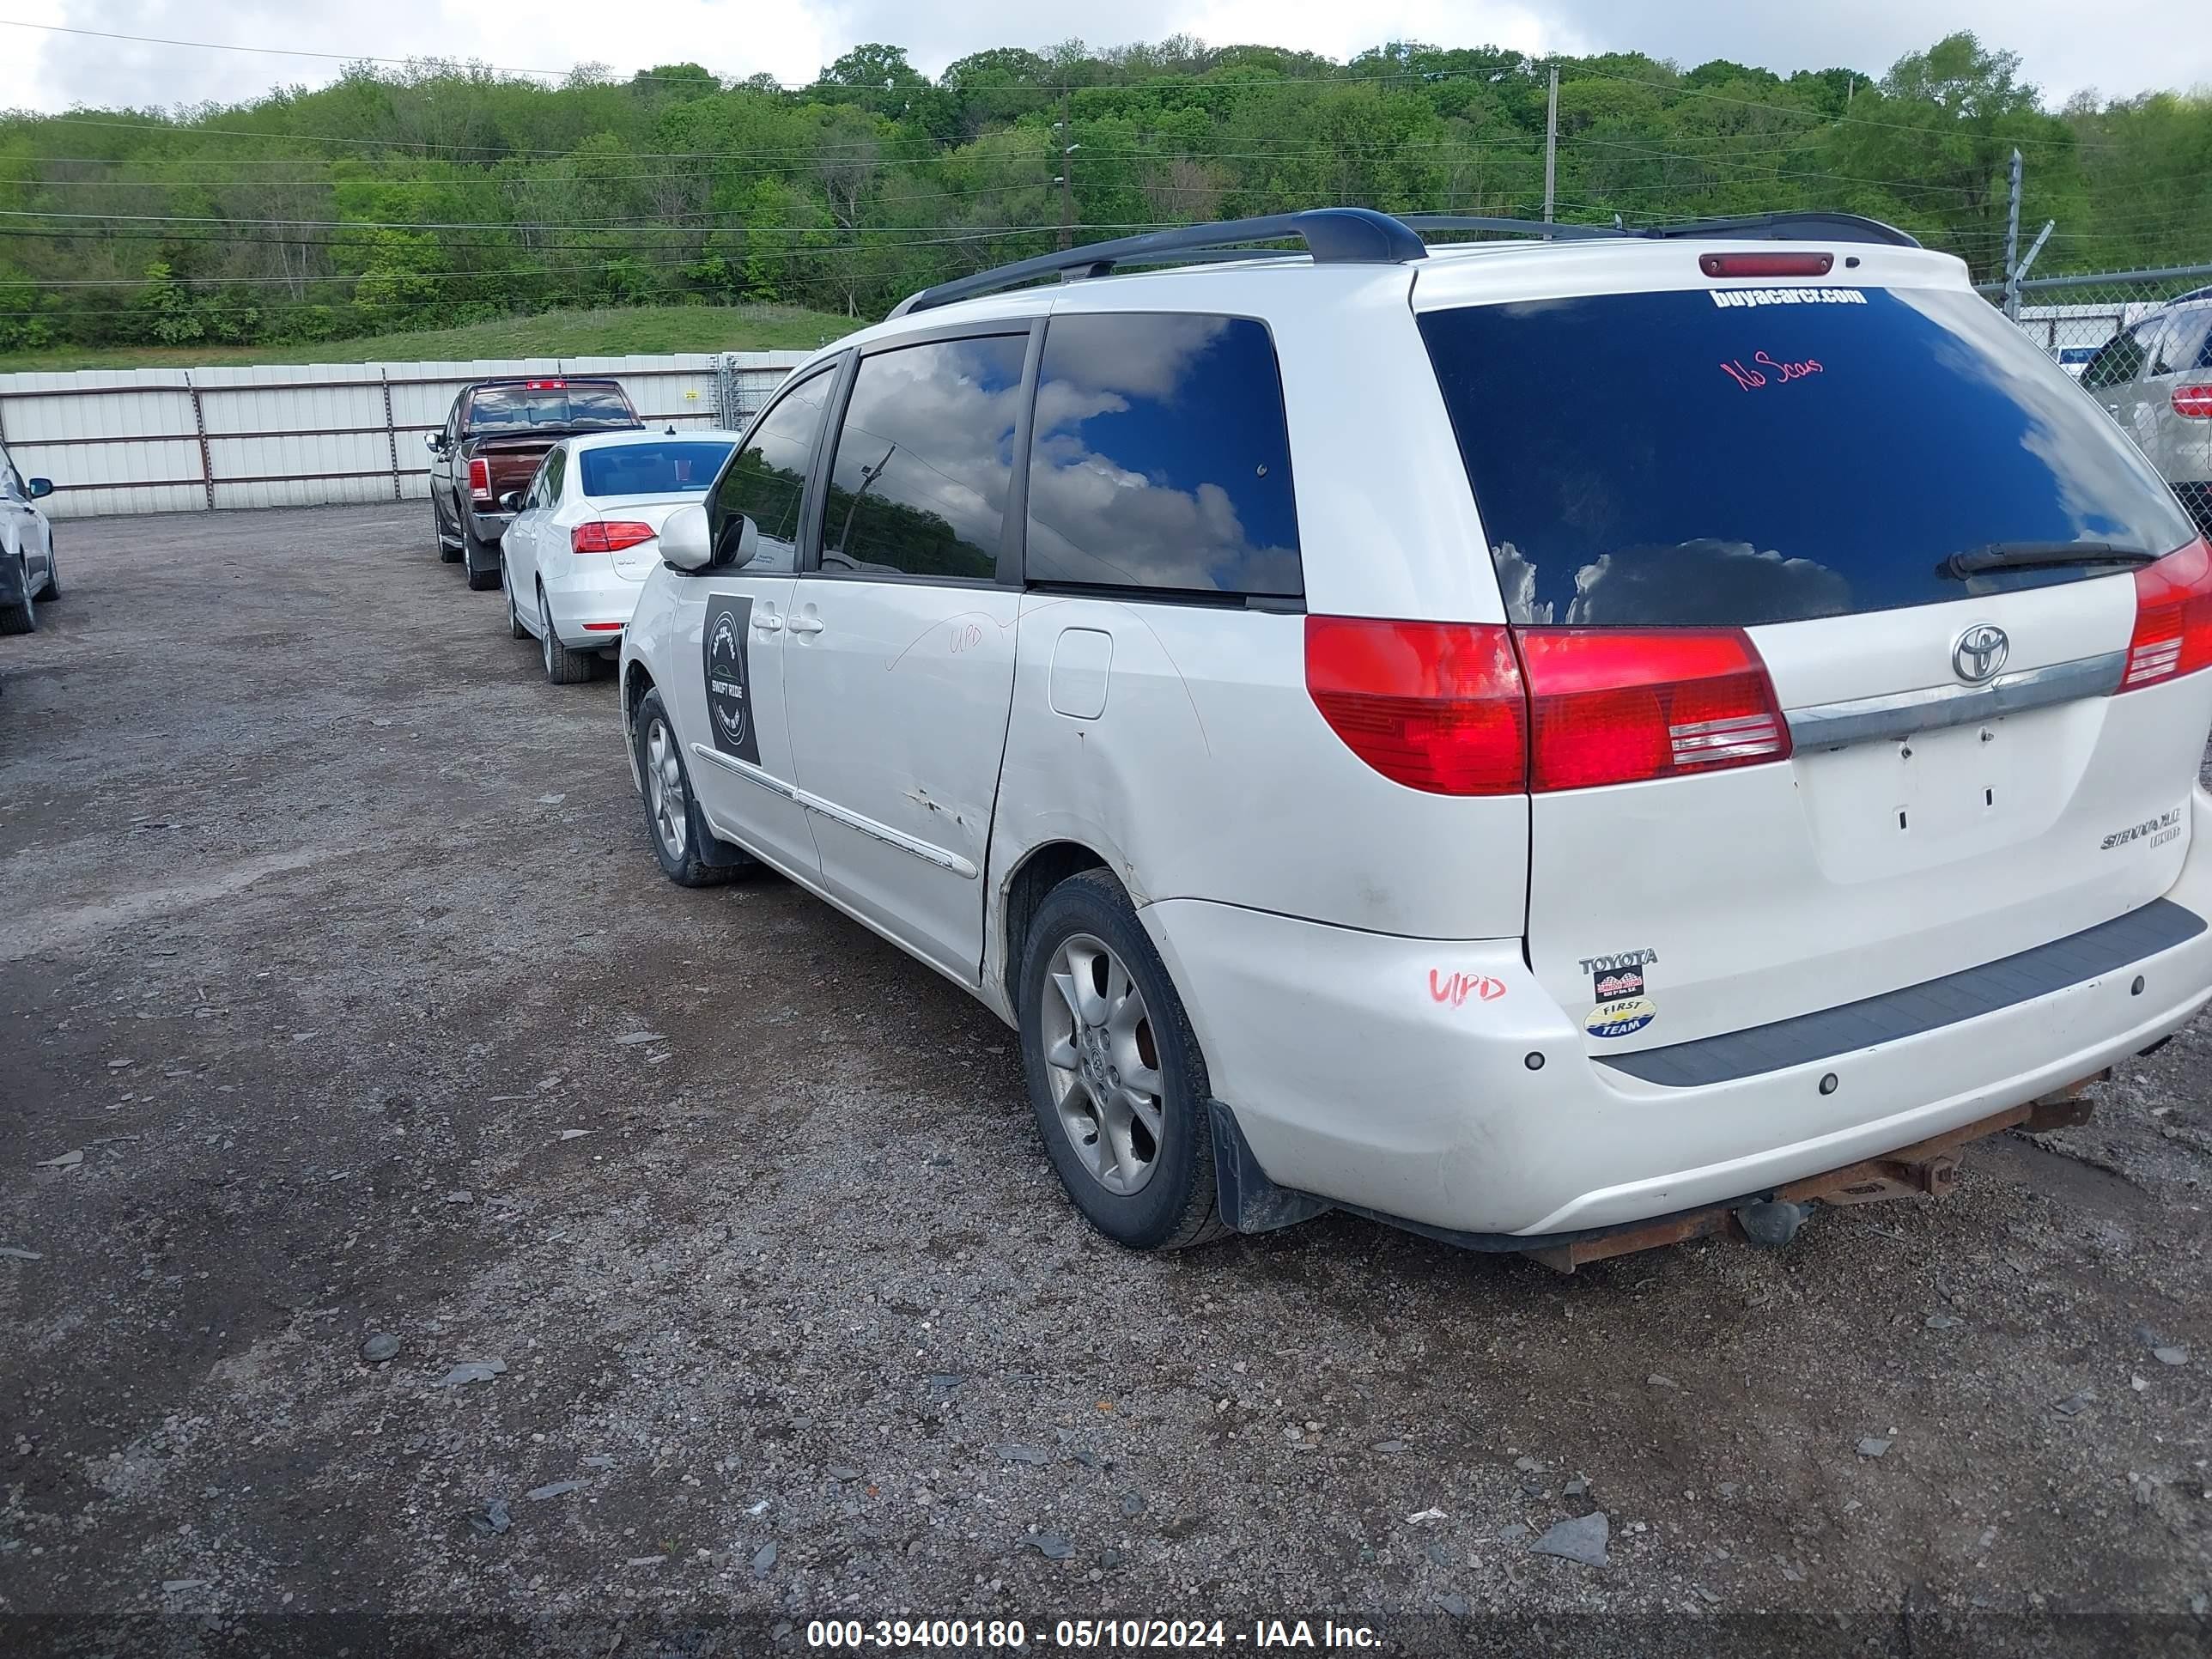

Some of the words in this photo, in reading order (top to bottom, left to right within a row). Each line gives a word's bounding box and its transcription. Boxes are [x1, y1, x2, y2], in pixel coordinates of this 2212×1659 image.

[1709, 289, 1869, 308] buyacarcr.com
[1720, 359, 1766, 392] No
[950, 624, 982, 653] UPD
[712, 679, 728, 698] SWIFT
[728, 683, 743, 699] RIDE
[1578, 948, 1658, 975] TOYOTA
[1603, 1001, 1644, 1016] FIRST
[1601, 1020, 1641, 1036] TEAM
